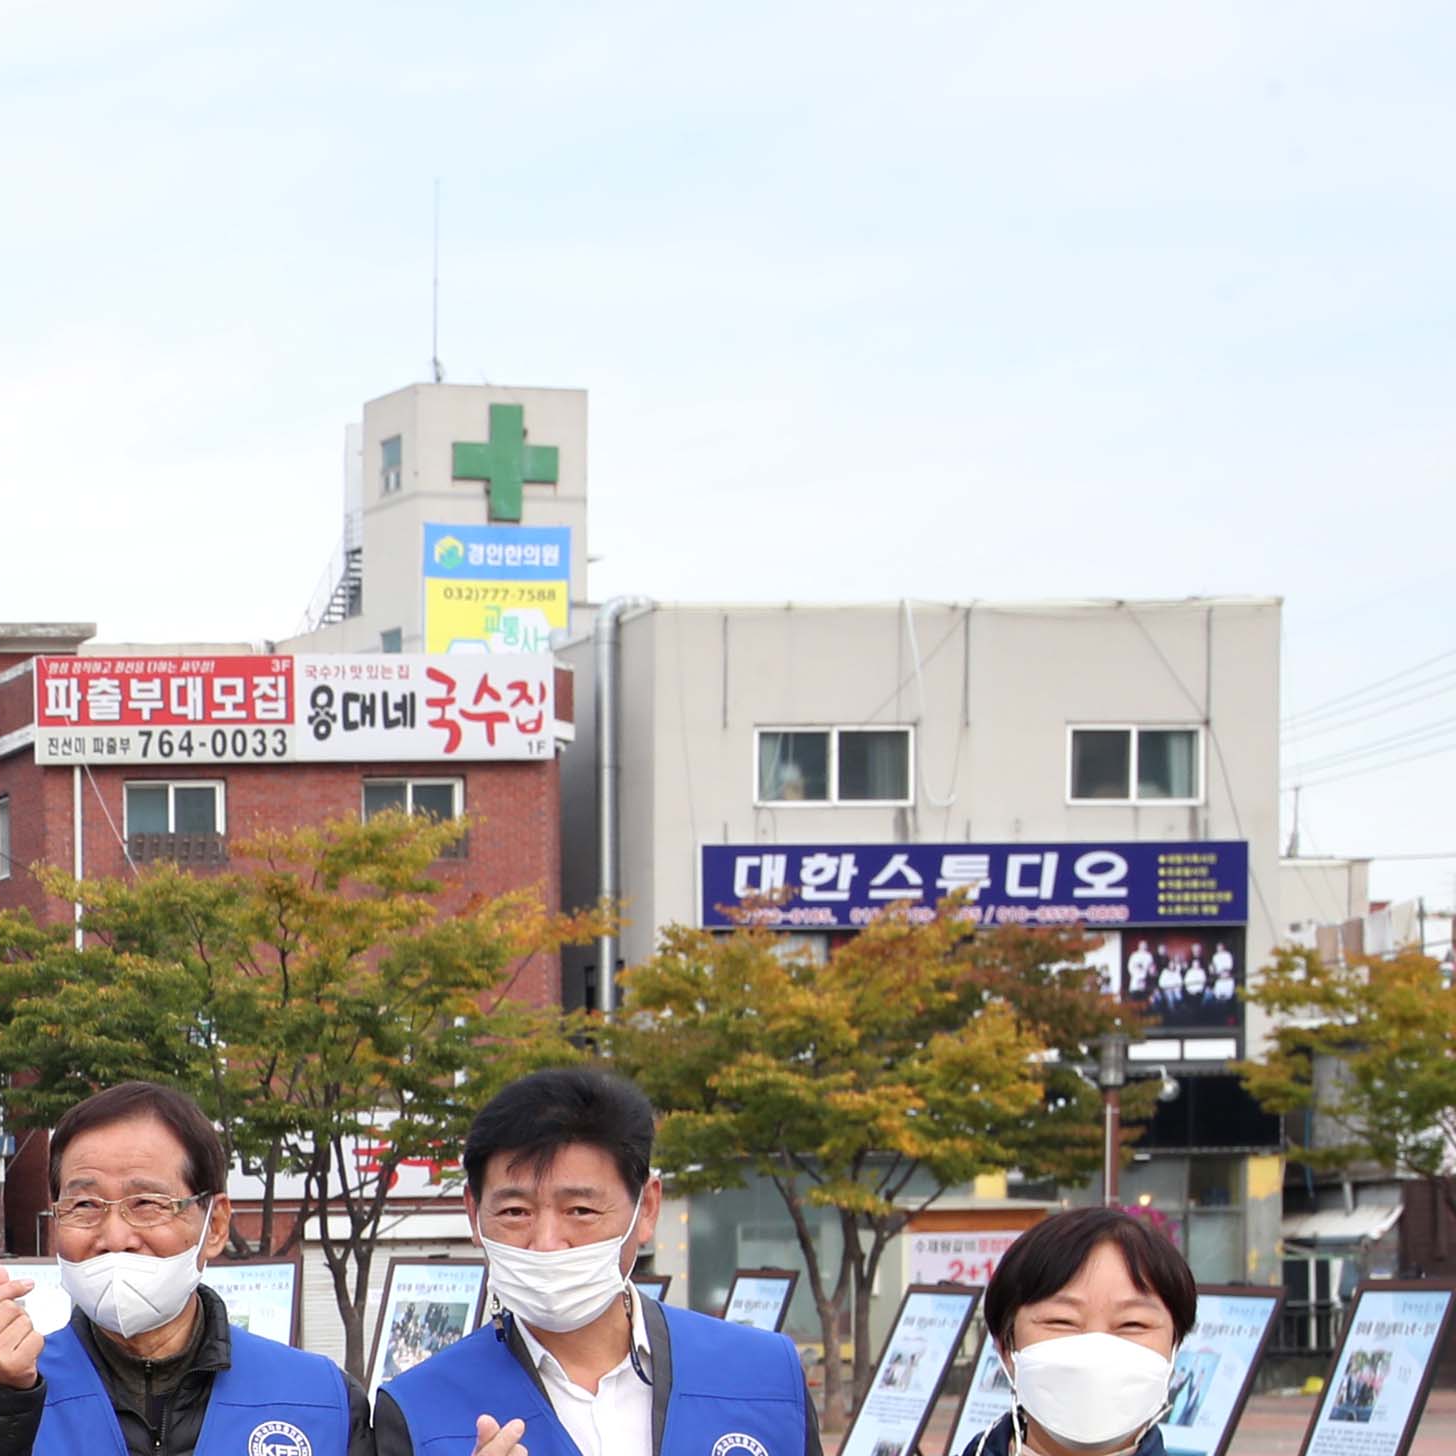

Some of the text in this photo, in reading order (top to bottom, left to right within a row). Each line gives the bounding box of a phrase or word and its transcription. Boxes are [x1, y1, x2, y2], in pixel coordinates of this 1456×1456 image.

[271, 659, 291, 673] 3F
[304, 664, 347, 681] 국수가
[397, 664, 410, 680] 집
[44, 675, 287, 722] 파출부대모집
[308, 666, 546, 754] 용대네 국수집
[138, 728, 288, 759] 764-0033
[527, 740, 547, 755] 1F
[733, 850, 1129, 901] 대한스튜디오
